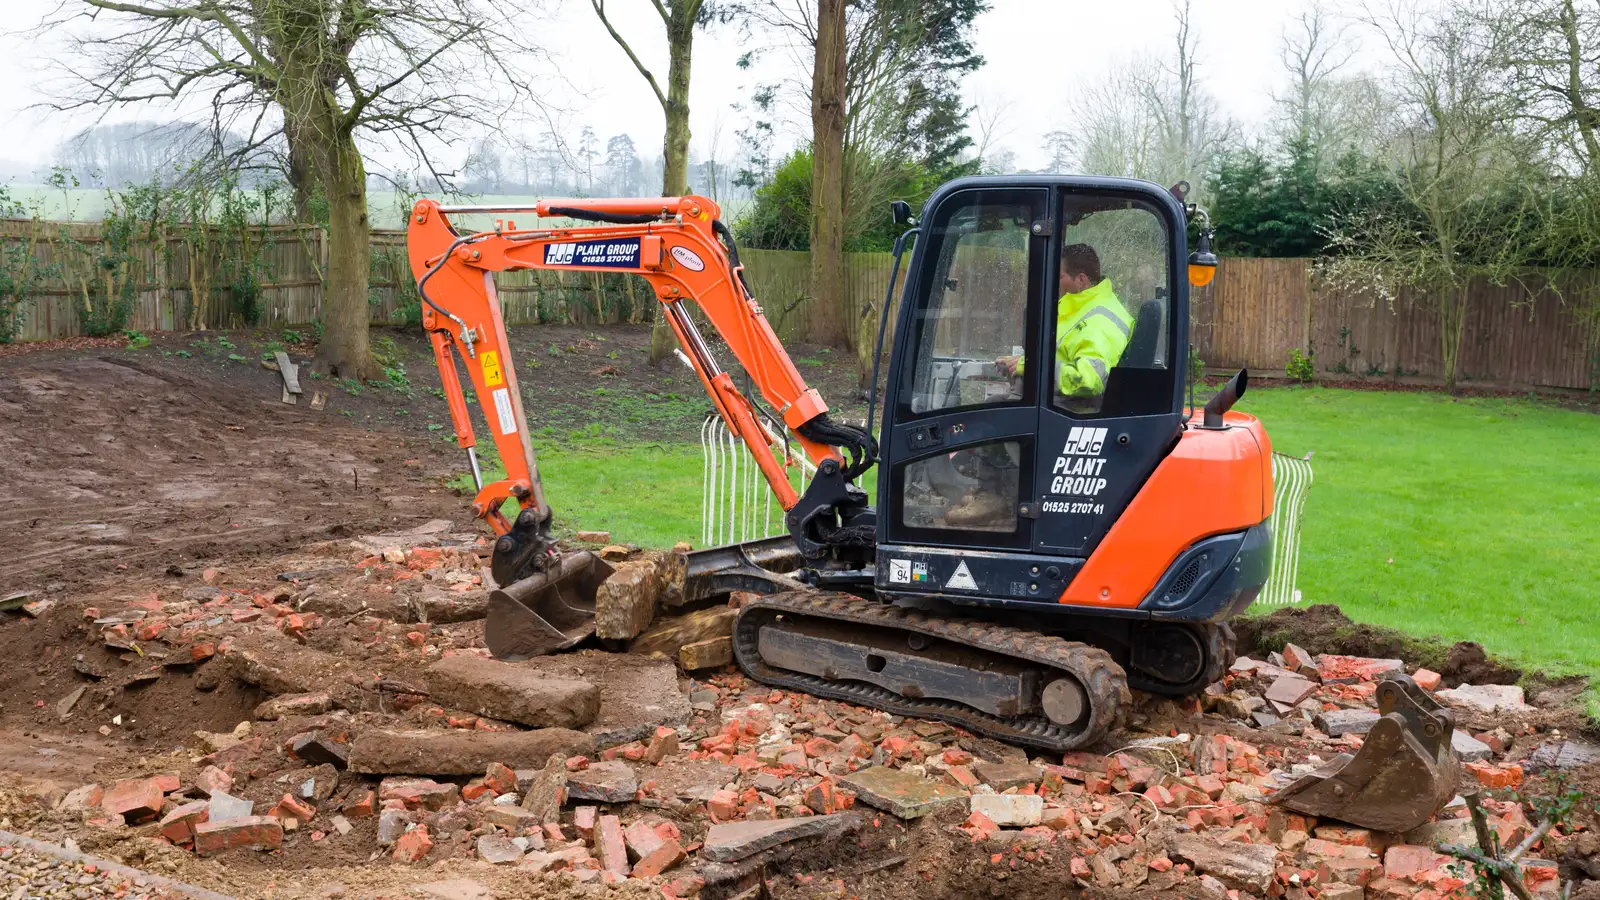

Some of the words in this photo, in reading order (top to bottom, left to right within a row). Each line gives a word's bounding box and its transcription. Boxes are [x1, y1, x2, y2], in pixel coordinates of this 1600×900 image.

[576, 244, 605, 256] PLANT
[606, 243, 639, 255] GROUP
[606, 255, 634, 263] 270741
[1052, 457, 1107, 476] PLANT
[1050, 476, 1107, 495] GROUP
[1042, 501, 1070, 513] 01525
[897, 569, 908, 581] 94
